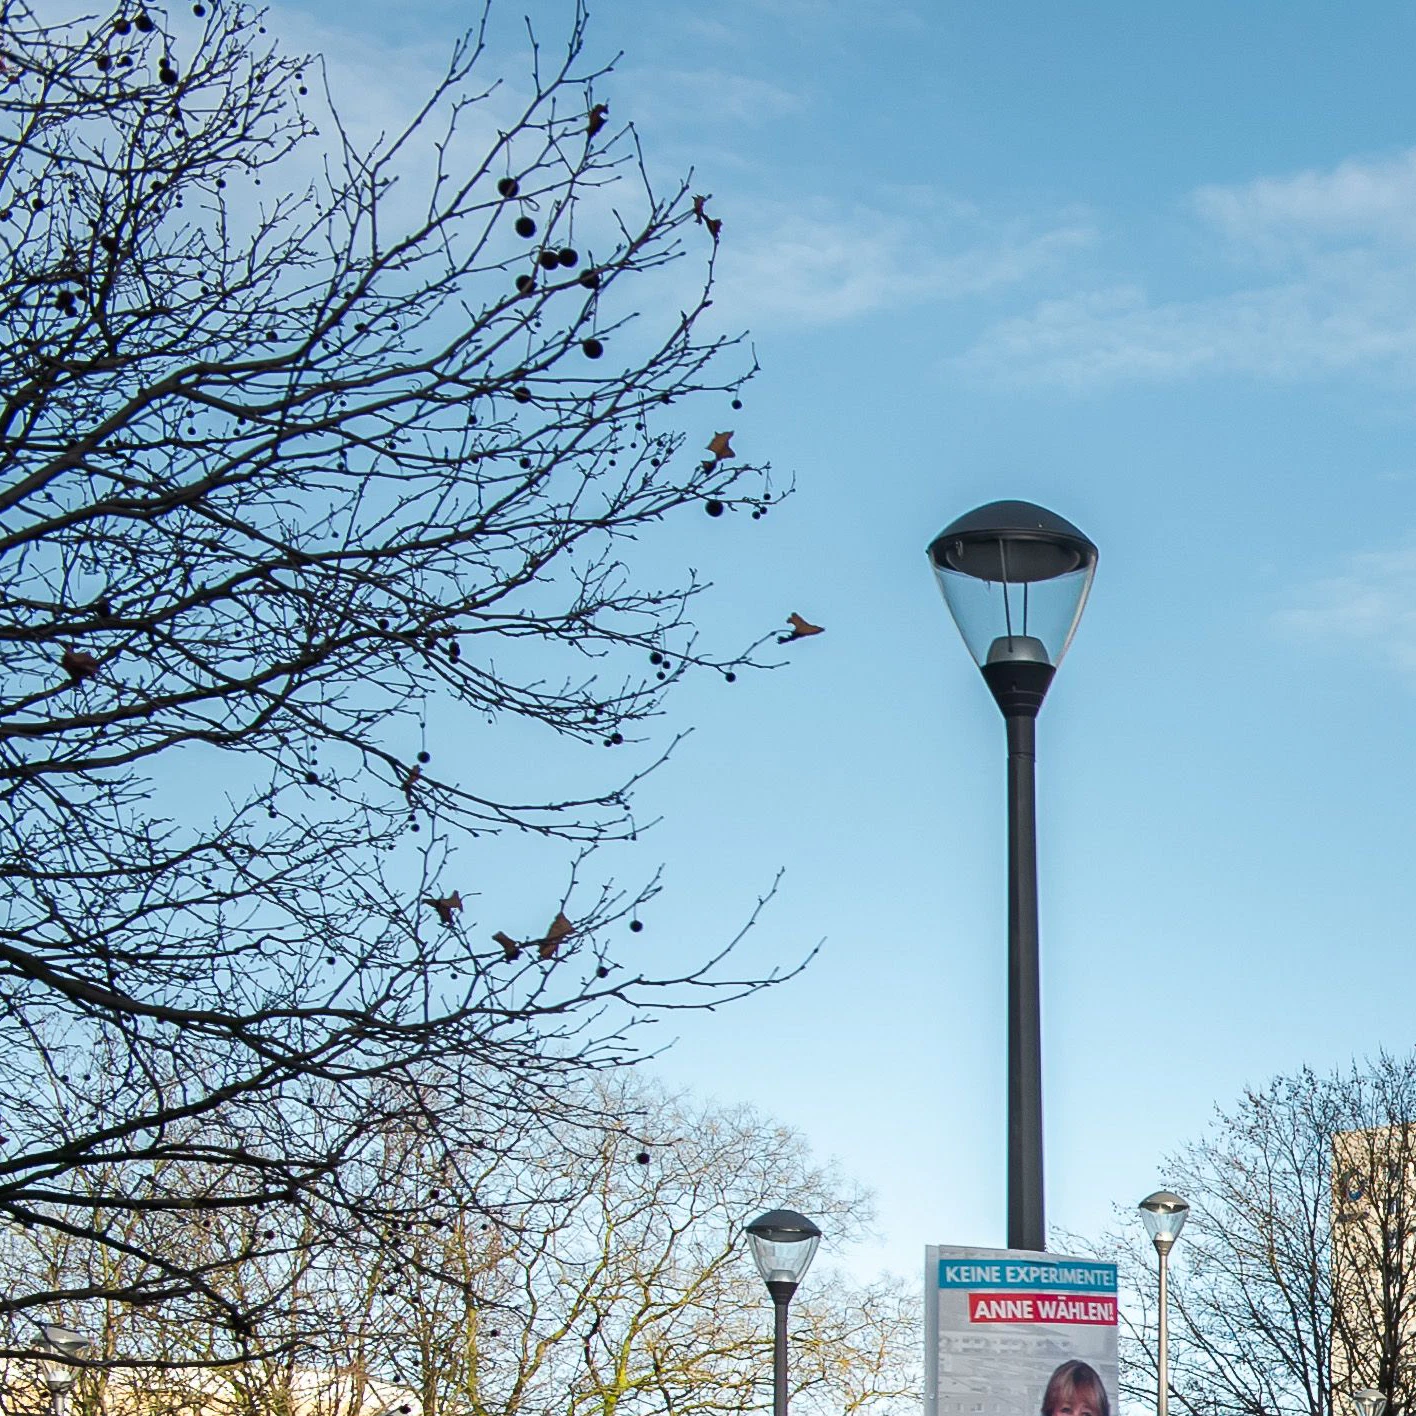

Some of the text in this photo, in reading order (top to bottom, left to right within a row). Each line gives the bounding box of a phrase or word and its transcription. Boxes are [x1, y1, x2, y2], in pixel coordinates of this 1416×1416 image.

[946, 1266, 1115, 1287] KEINE EXPERIMENTE!
[974, 1296, 1115, 1321] ANNE WÄHLEN!
